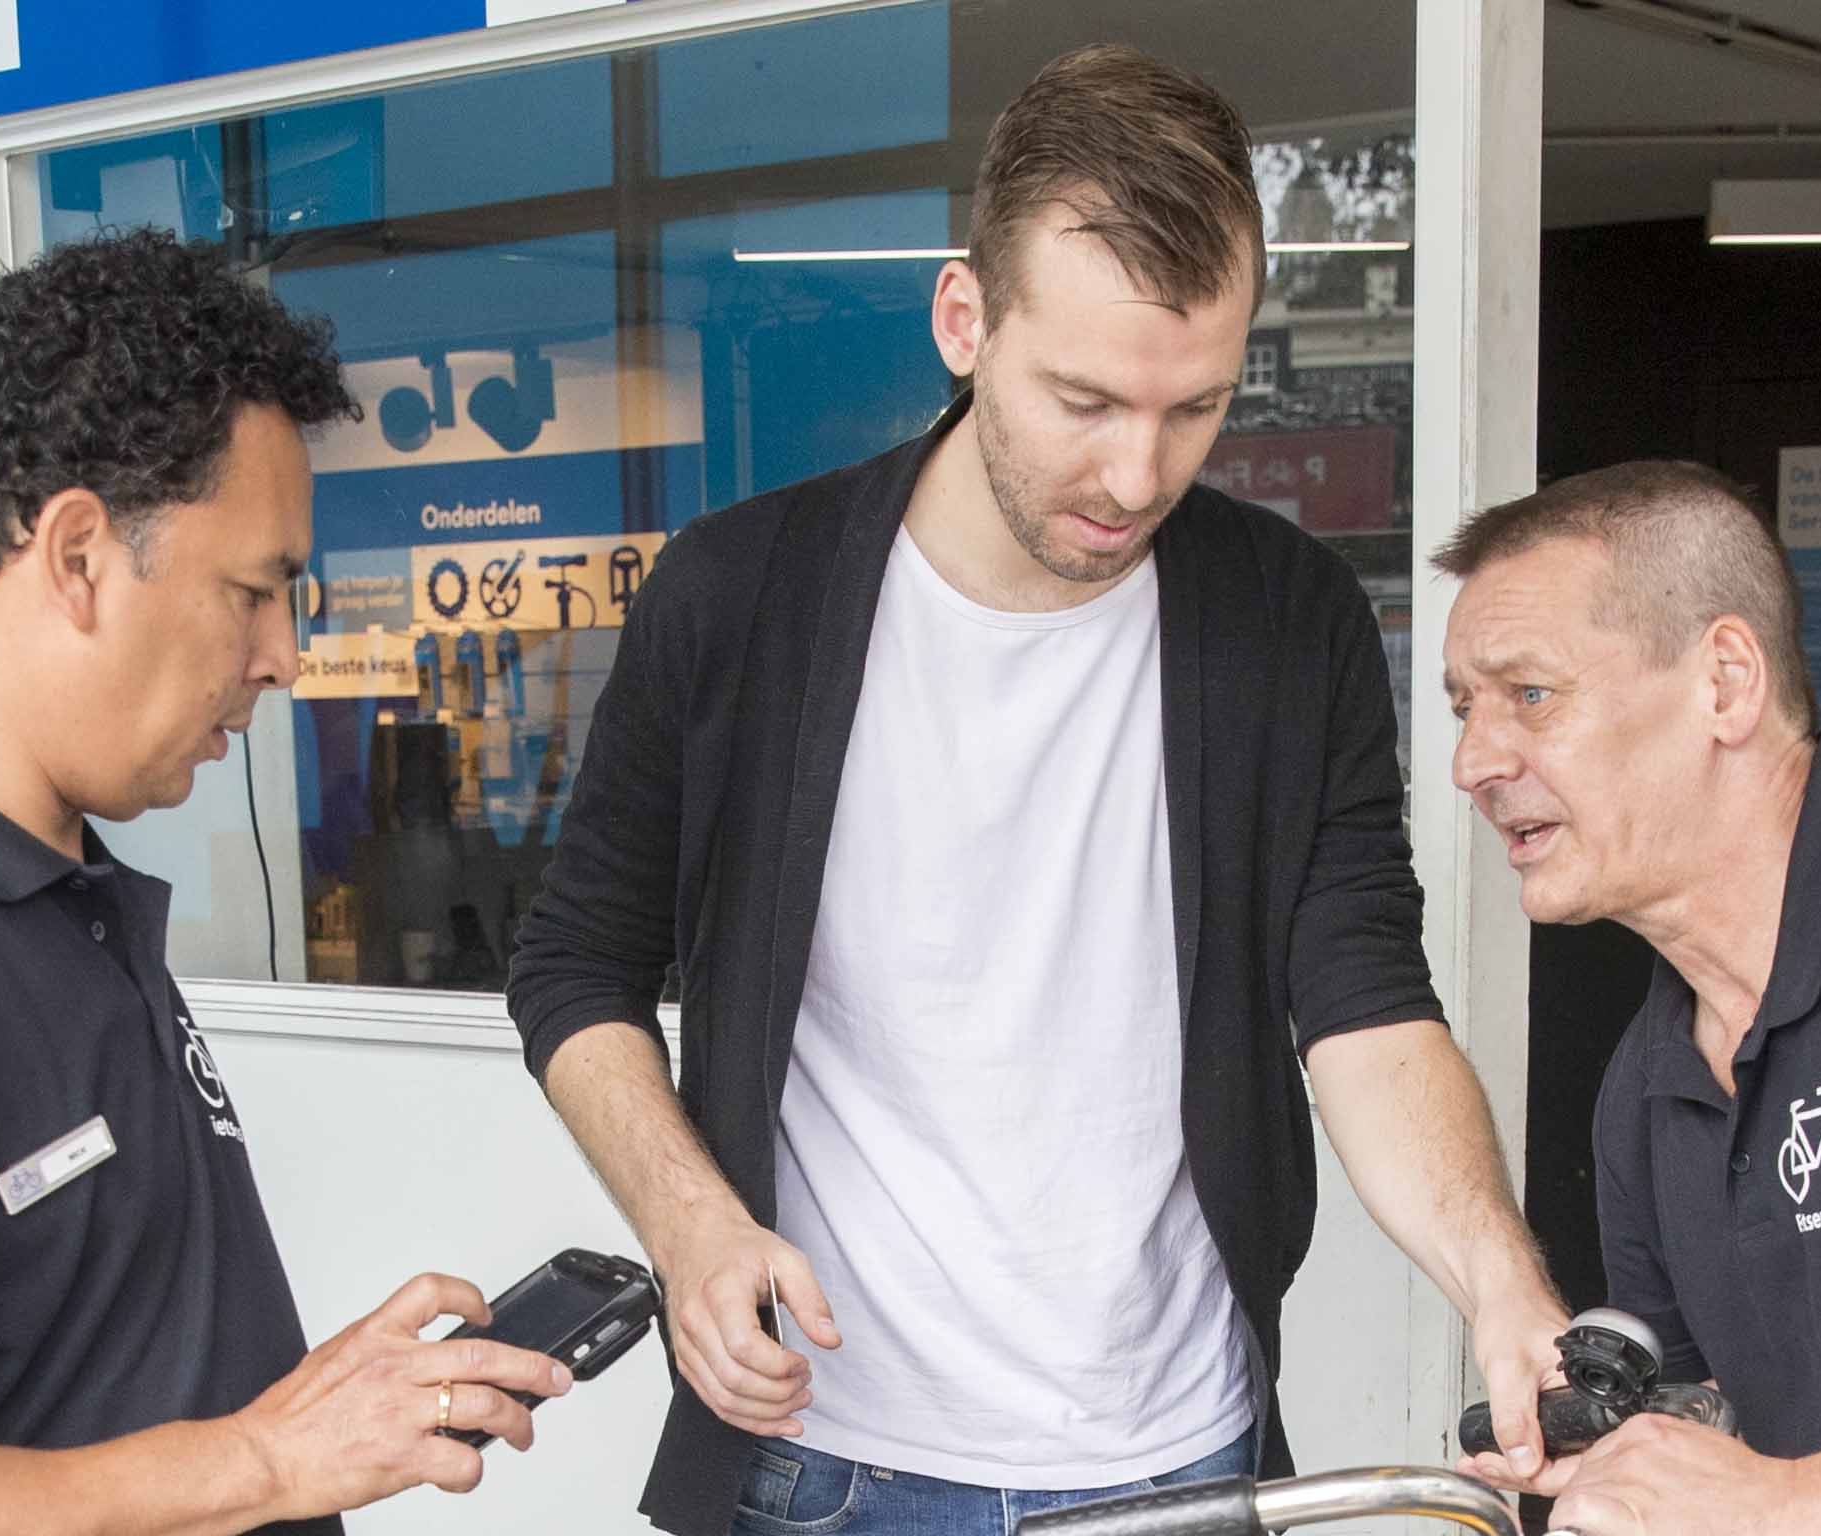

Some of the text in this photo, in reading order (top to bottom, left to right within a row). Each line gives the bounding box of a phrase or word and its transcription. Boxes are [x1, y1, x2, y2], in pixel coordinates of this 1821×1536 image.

[1790, 466, 1815, 483] De
[421, 499, 542, 531] Onderdelen
[321, 656, 366, 676] beste
